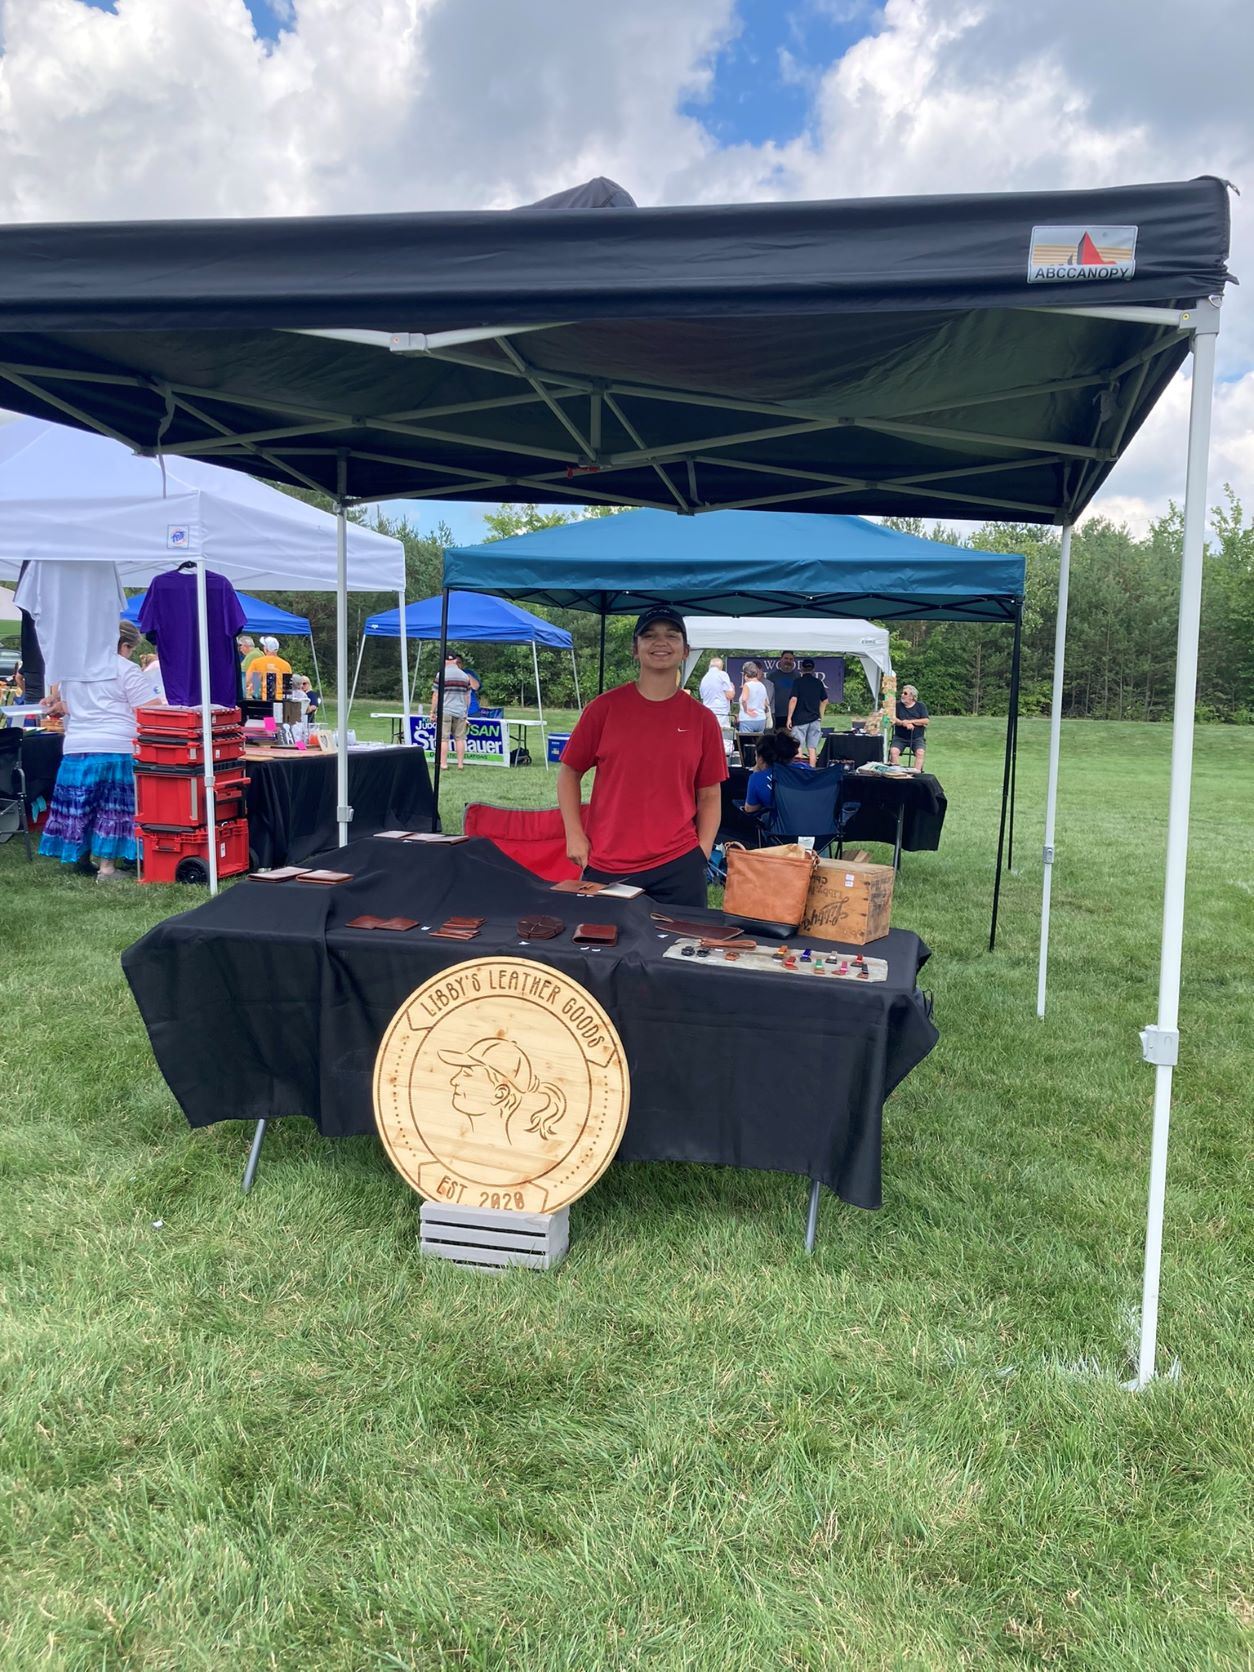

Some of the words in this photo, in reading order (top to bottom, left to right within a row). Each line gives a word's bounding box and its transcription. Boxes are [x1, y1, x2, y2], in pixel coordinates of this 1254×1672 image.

[1034, 267, 1130, 280] ABCCANOPY
[420, 973, 482, 1018] LIBBY'S
[488, 968, 562, 1006] LEATHER
[562, 997, 606, 1049] GOODS
[479, 1189, 525, 1210] 2020
